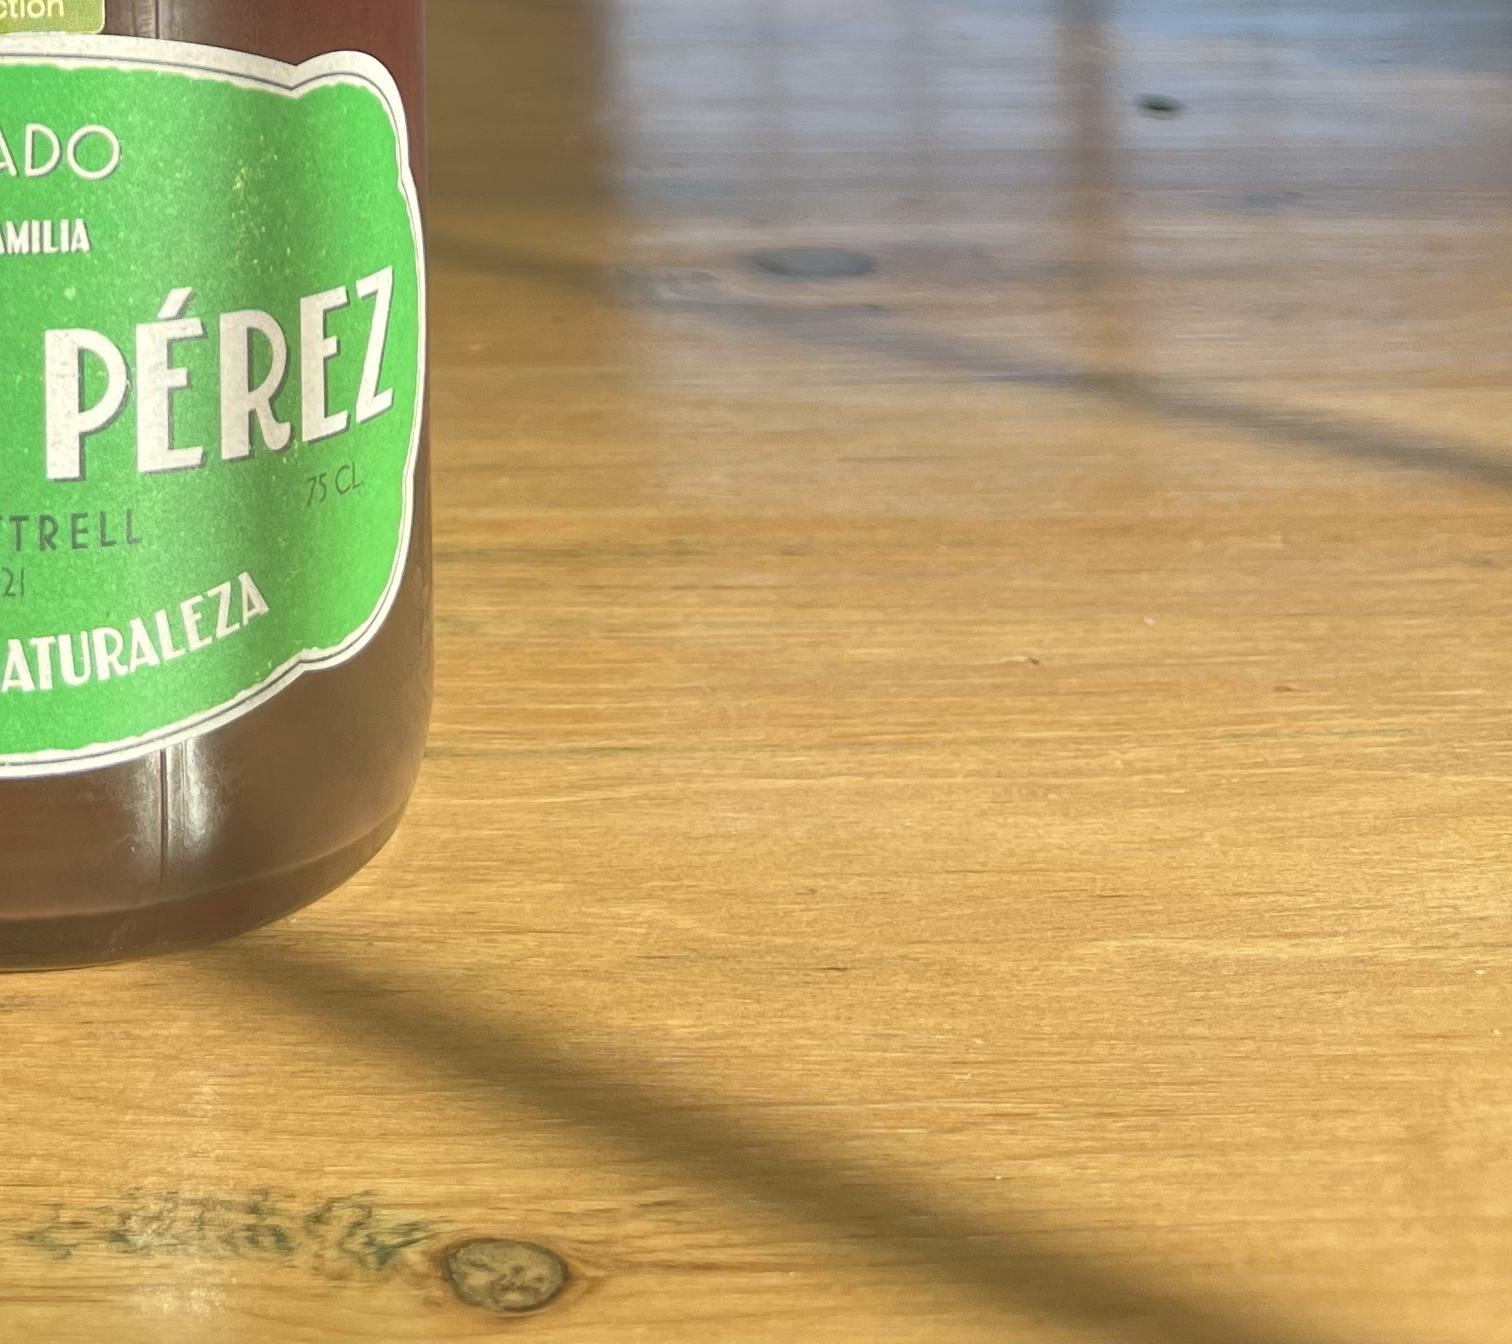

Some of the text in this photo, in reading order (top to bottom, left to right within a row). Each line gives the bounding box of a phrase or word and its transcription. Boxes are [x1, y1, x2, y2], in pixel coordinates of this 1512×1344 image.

[43, 264, 394, 482] PÉREZ
[306, 460, 365, 508] 75 CL.
